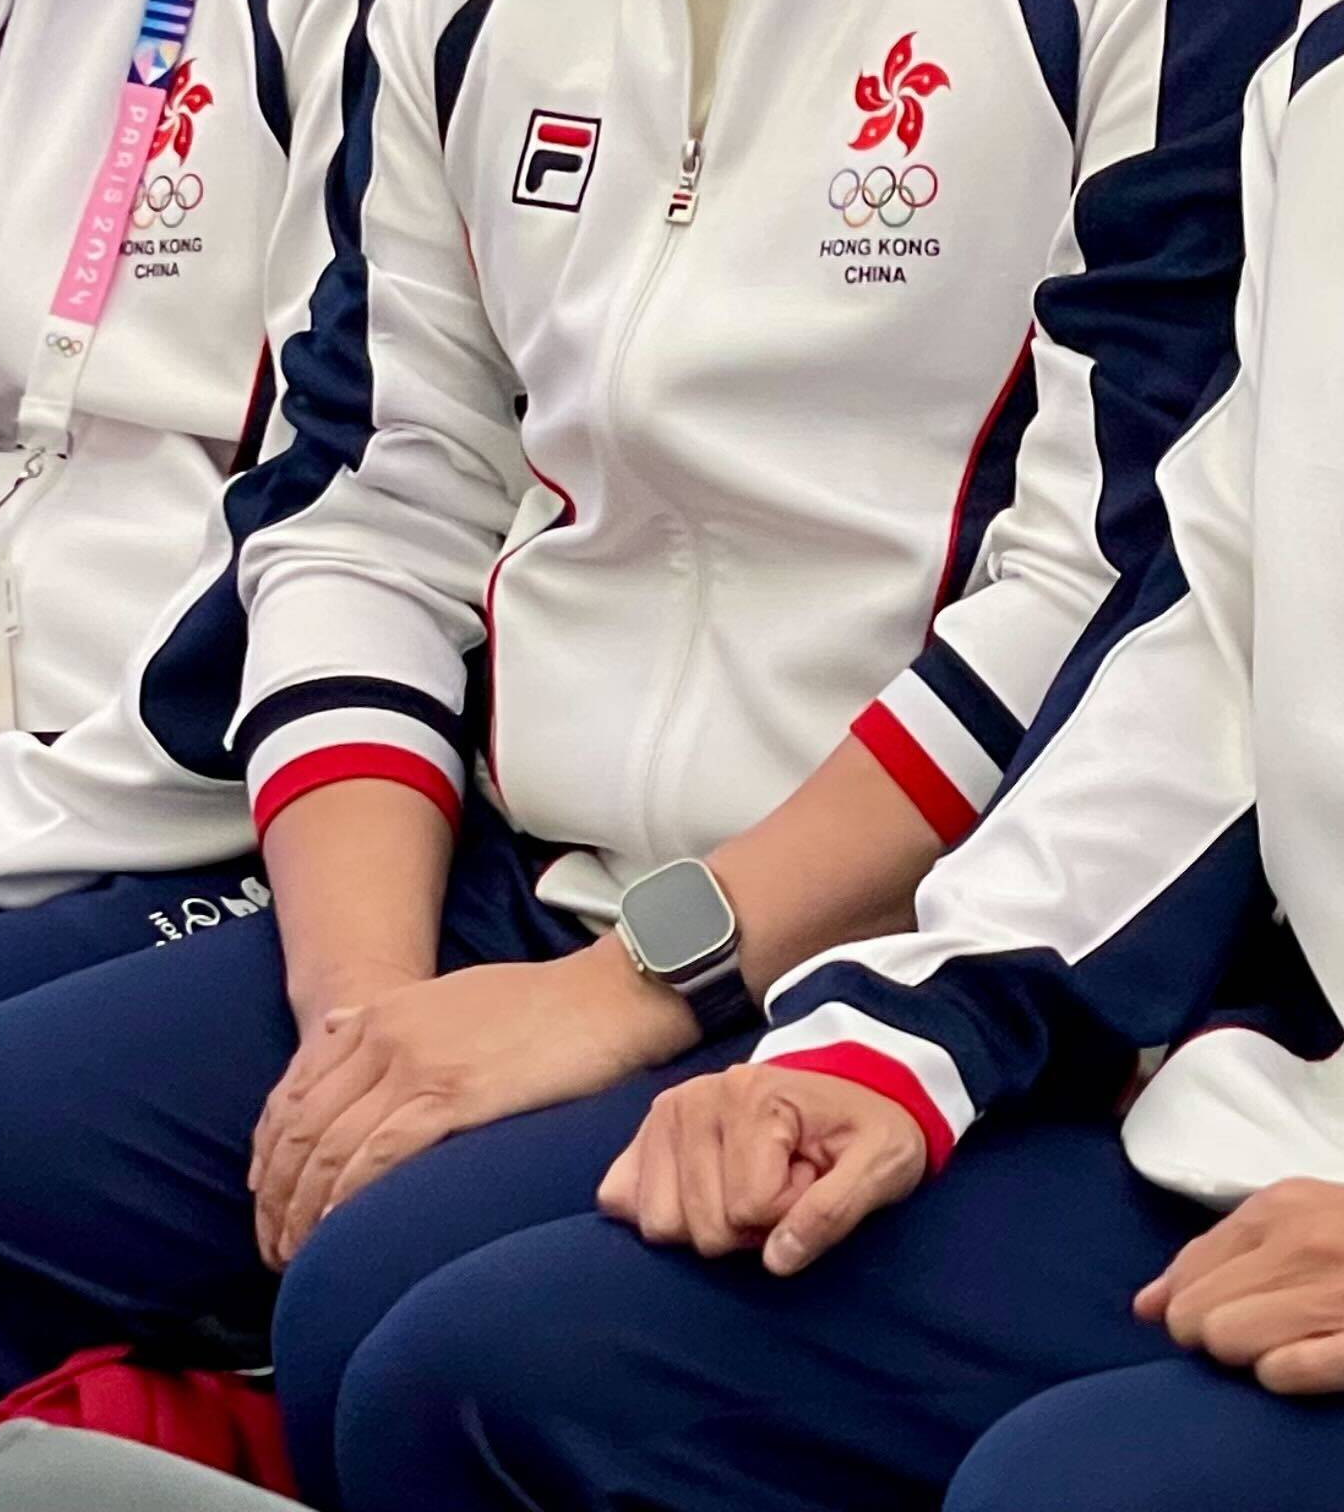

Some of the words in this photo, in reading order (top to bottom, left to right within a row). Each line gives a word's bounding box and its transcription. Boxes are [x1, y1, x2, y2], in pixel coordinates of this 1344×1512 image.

[102, 105, 150, 205] PARIS
[159, 237, 203, 255] KONG
[819, 237, 872, 257] HONG
[877, 237, 940, 257] KONG
[67, 211, 117, 306] 2024
[134, 262, 180, 279] CHINA
[844, 265, 908, 284] CHINA
